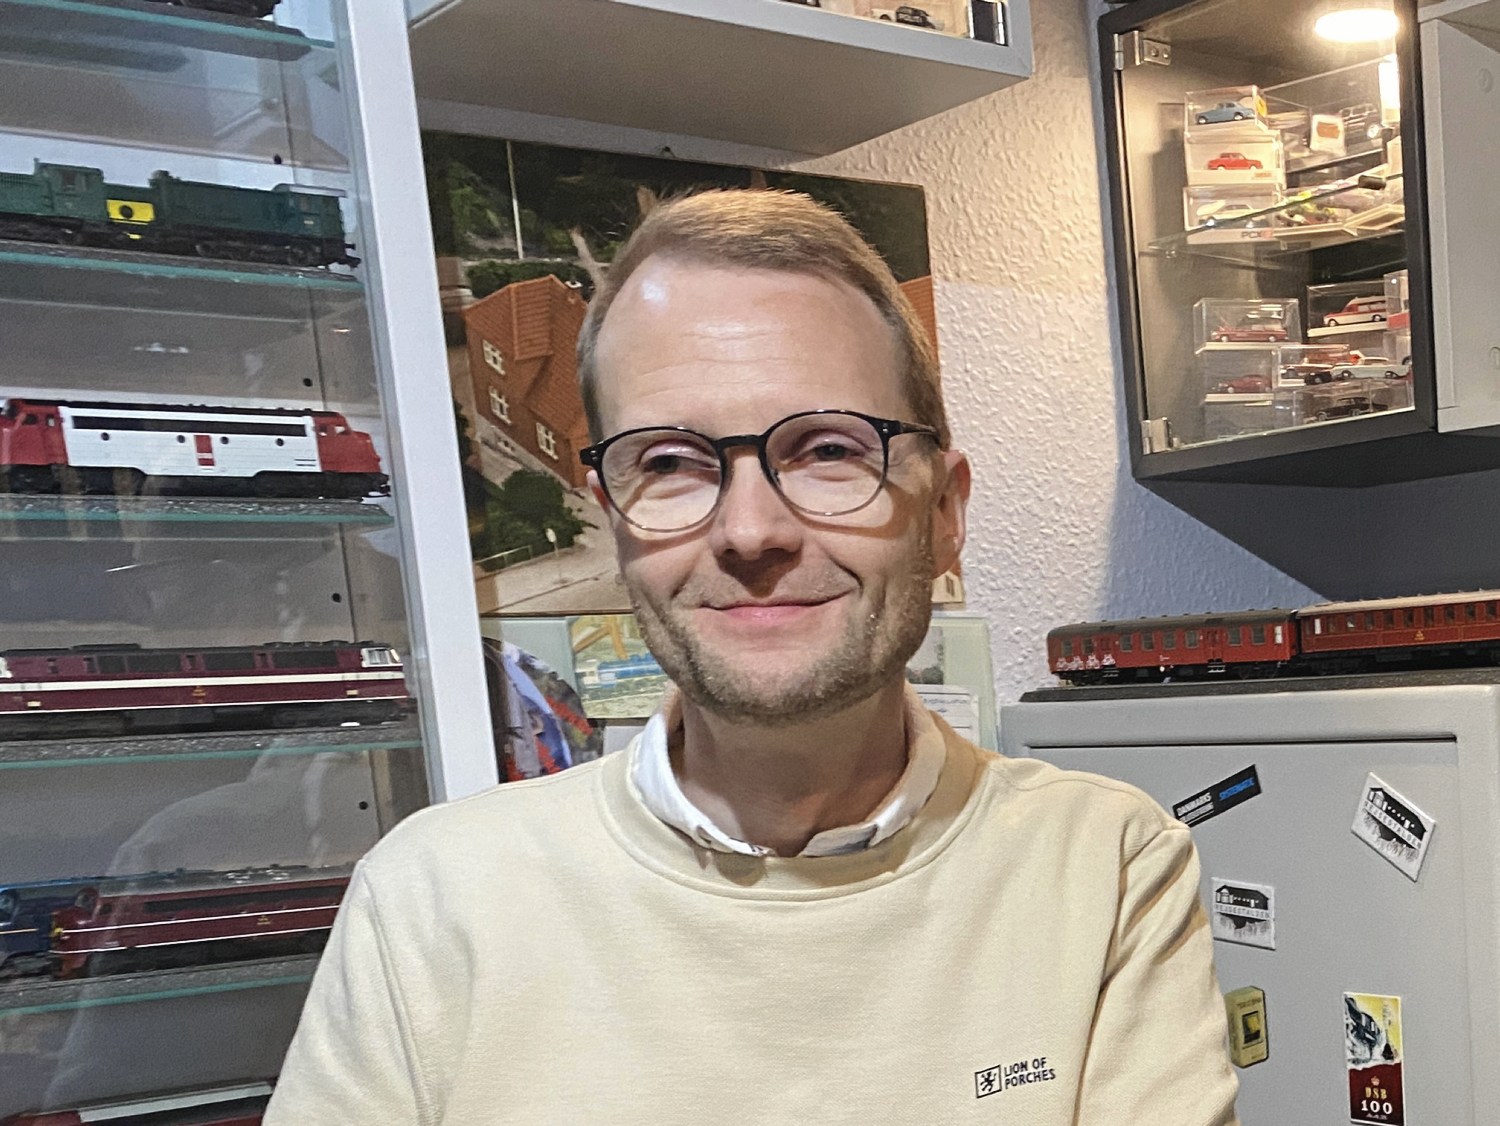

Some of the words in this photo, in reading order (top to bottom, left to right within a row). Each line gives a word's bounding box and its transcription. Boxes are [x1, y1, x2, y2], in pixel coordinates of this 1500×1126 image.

[1004, 1060, 1028, 1077] LION
[1032, 1057, 1046, 1070] OF
[1005, 1068, 1056, 1090] PORCHES
[1365, 1086, 1387, 1100] DSB
[1361, 1099, 1393, 1115] 100
